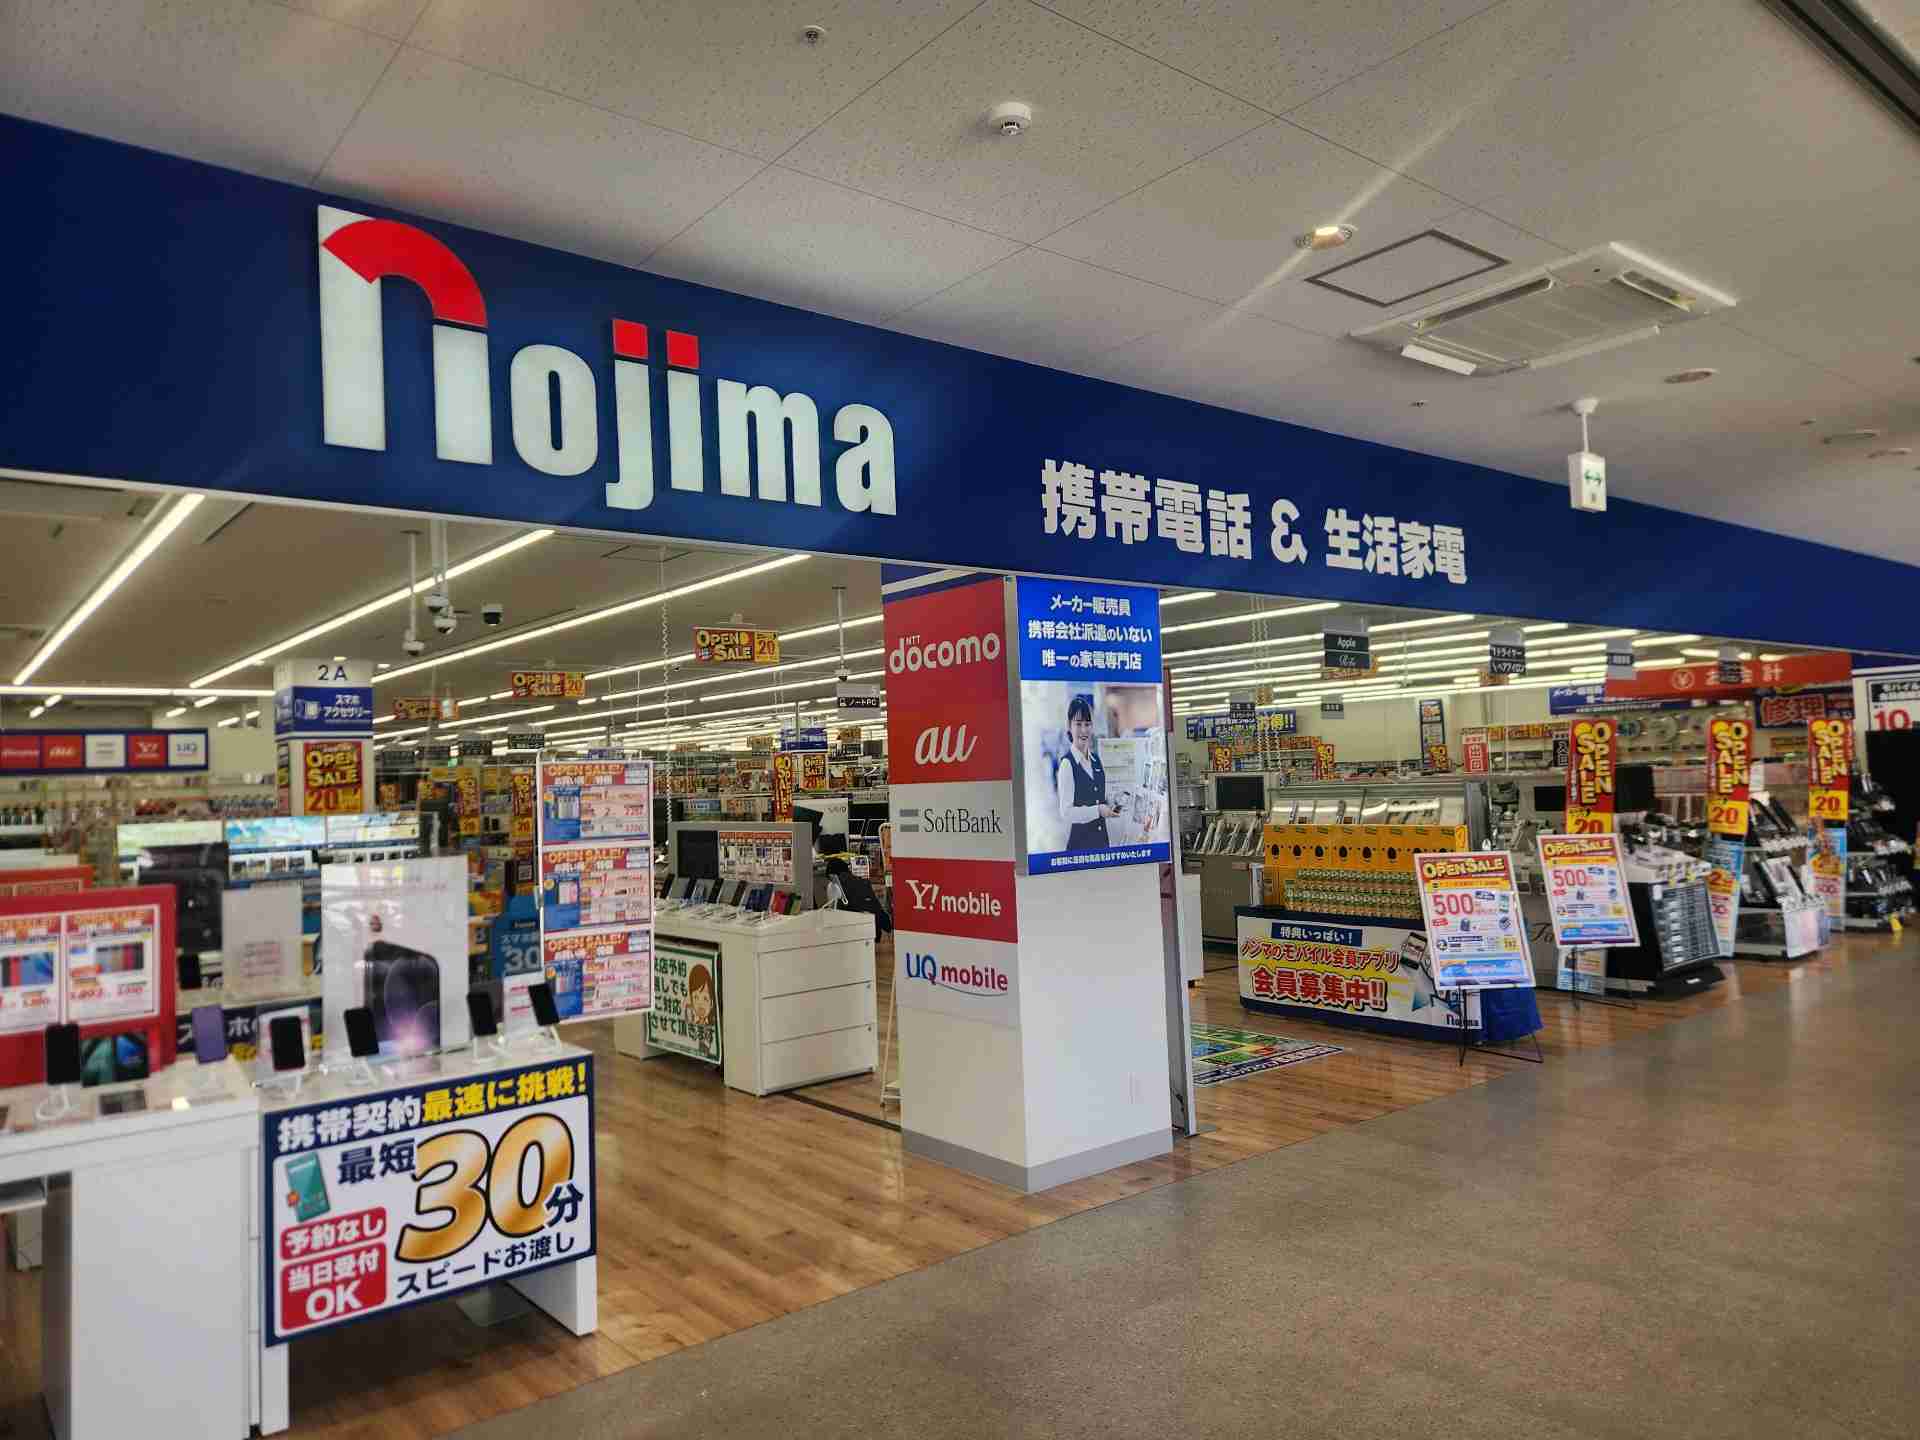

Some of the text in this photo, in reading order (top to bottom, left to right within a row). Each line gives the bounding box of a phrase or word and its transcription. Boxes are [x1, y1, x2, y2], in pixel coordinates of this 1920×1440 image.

[318, 204, 897, 516] nojima
[1041, 459, 1468, 584] 携帯電話 & 生活家電
[1050, 595, 1131, 616] メーカー販売員
[696, 630, 739, 647] OPEN
[1029, 620, 1152, 642] 携帯会社派遣のいない
[1337, 636, 1356, 649] Apple
[713, 645, 752, 661] SALE
[889, 633, 1000, 674] docomo
[1042, 649, 1142, 670] 唯一の家電専門店
[335, 694, 360, 705] スマホ
[305, 750, 357, 769] OPEN
[914, 722, 978, 765] au
[1594, 722, 1613, 794] OPEN
[1730, 721, 1749, 785] OPEN
[1815, 731, 1833, 785] SALE
[1828, 720, 1848, 776] OPEN
[308, 767, 359, 788] SALE
[1576, 733, 1597, 804] SALE
[1714, 732, 1733, 794] SALE
[924, 808, 1002, 834] SoftBank
[1711, 806, 1738, 824] 20
[1815, 796, 1840, 811] 20
[1552, 868, 1586, 887] 500
[1432, 893, 1474, 916] 500
[905, 953, 1008, 991] UQ mobile
[1241, 936, 1399, 973] ノジマのモバイル会員アプリ
[285, 1216, 384, 1256] 予約なし
[287, 1249, 380, 1293] 当日受付
[396, 1231, 576, 1300] スピードお渡し
[304, 1281, 363, 1321] OK
